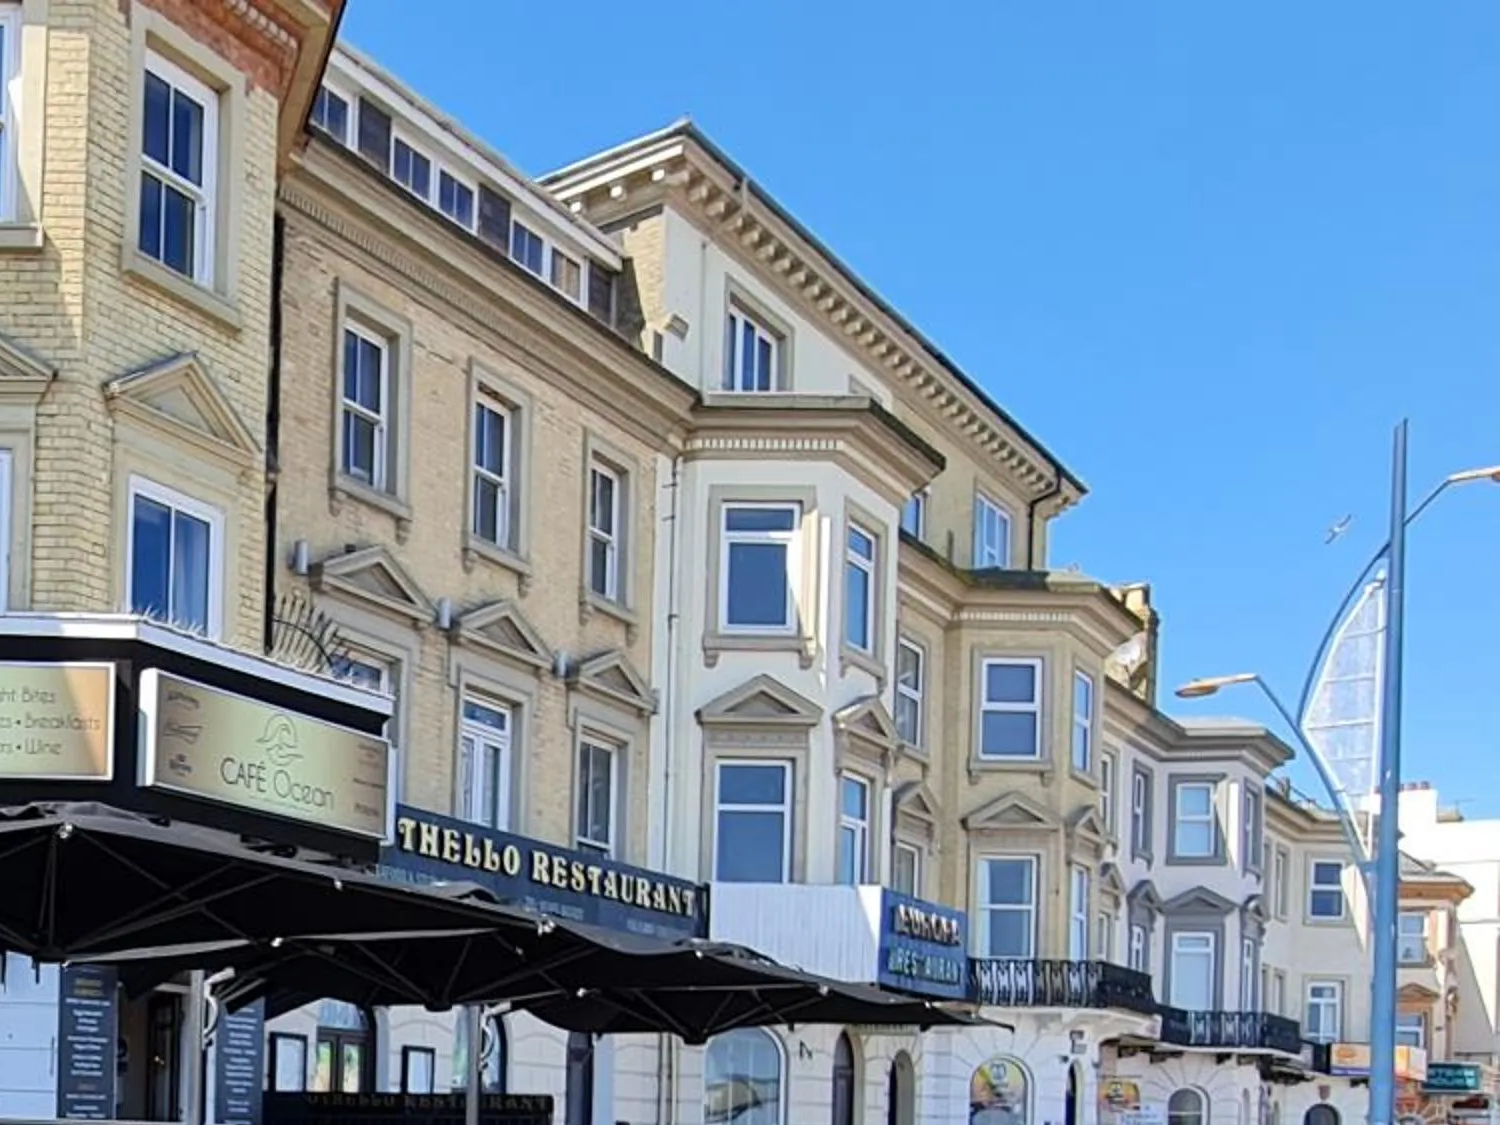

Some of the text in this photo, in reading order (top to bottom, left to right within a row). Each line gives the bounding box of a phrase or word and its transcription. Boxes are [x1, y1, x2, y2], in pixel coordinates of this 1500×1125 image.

[21, 687, 57, 705] Bites
[24, 712, 102, 732] Breakfasts
[24, 738, 62, 756] Wine
[219, 756, 267, 794] CAFÉ
[273, 769, 335, 811] Ocean
[398, 816, 696, 917] THELLO RESTAURANT
